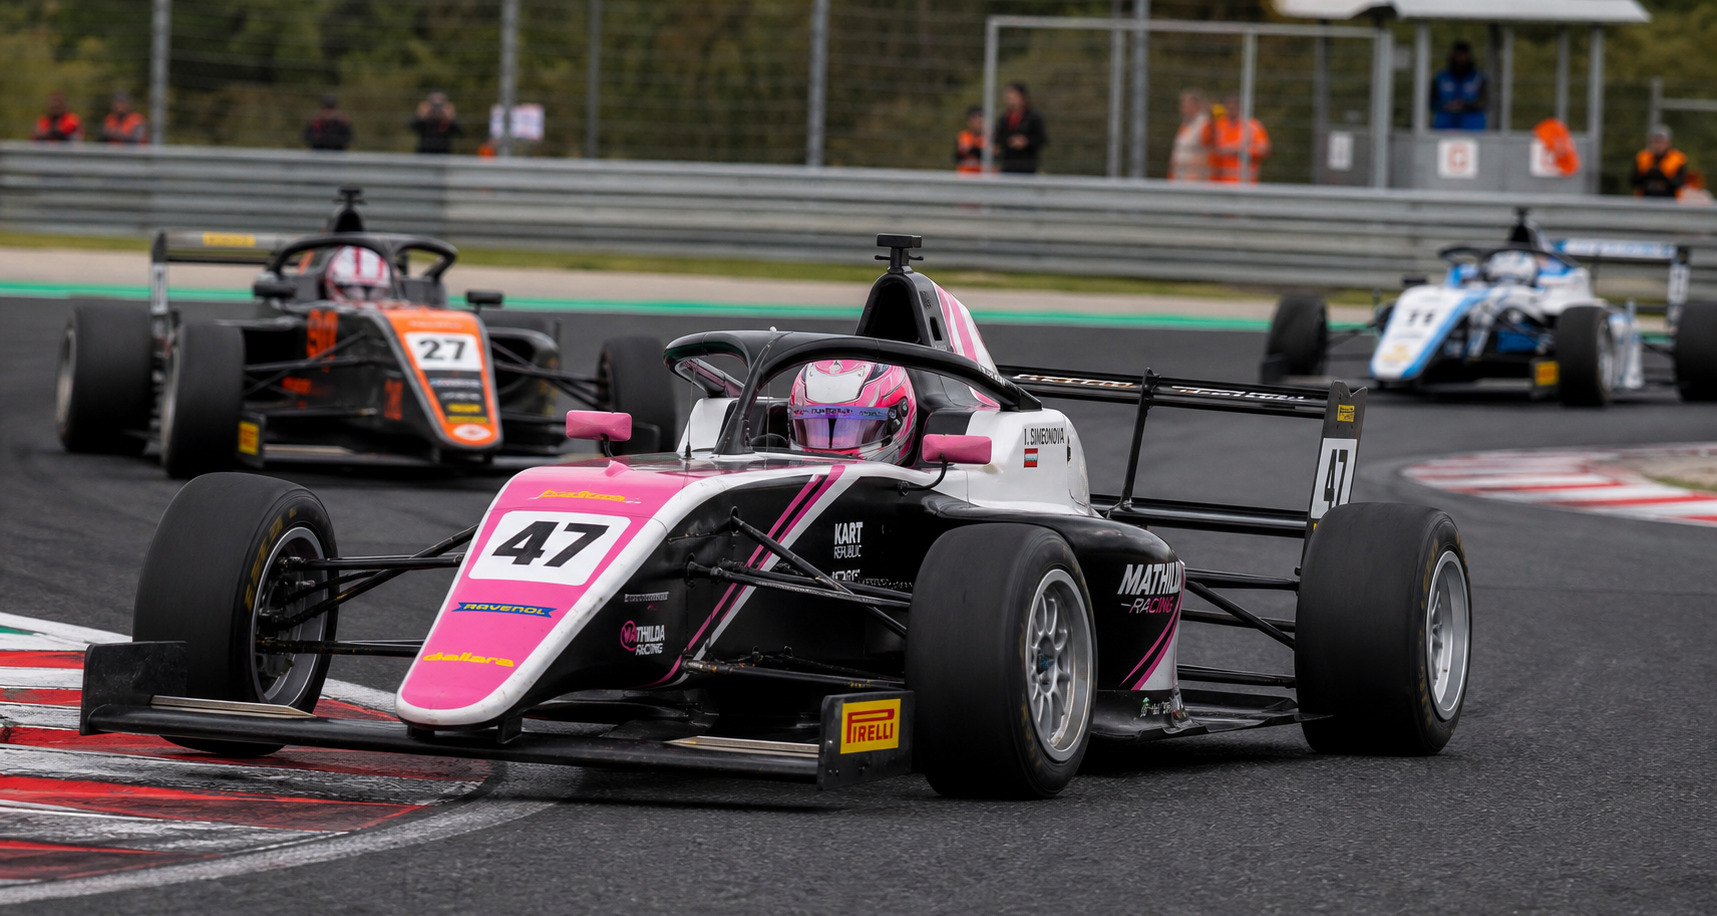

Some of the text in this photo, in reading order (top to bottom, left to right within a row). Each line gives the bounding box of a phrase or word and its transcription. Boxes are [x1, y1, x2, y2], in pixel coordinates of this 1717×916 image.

[419, 339, 467, 361] 27
[1323, 448, 1349, 510] 47
[491, 520, 610, 568] 47
[834, 521, 864, 545] KART
[463, 603, 546, 616] RAVENOL
[1128, 596, 1175, 614] RACING
[422, 651, 515, 668] dallara
[846, 708, 896, 745] PIRELLI
